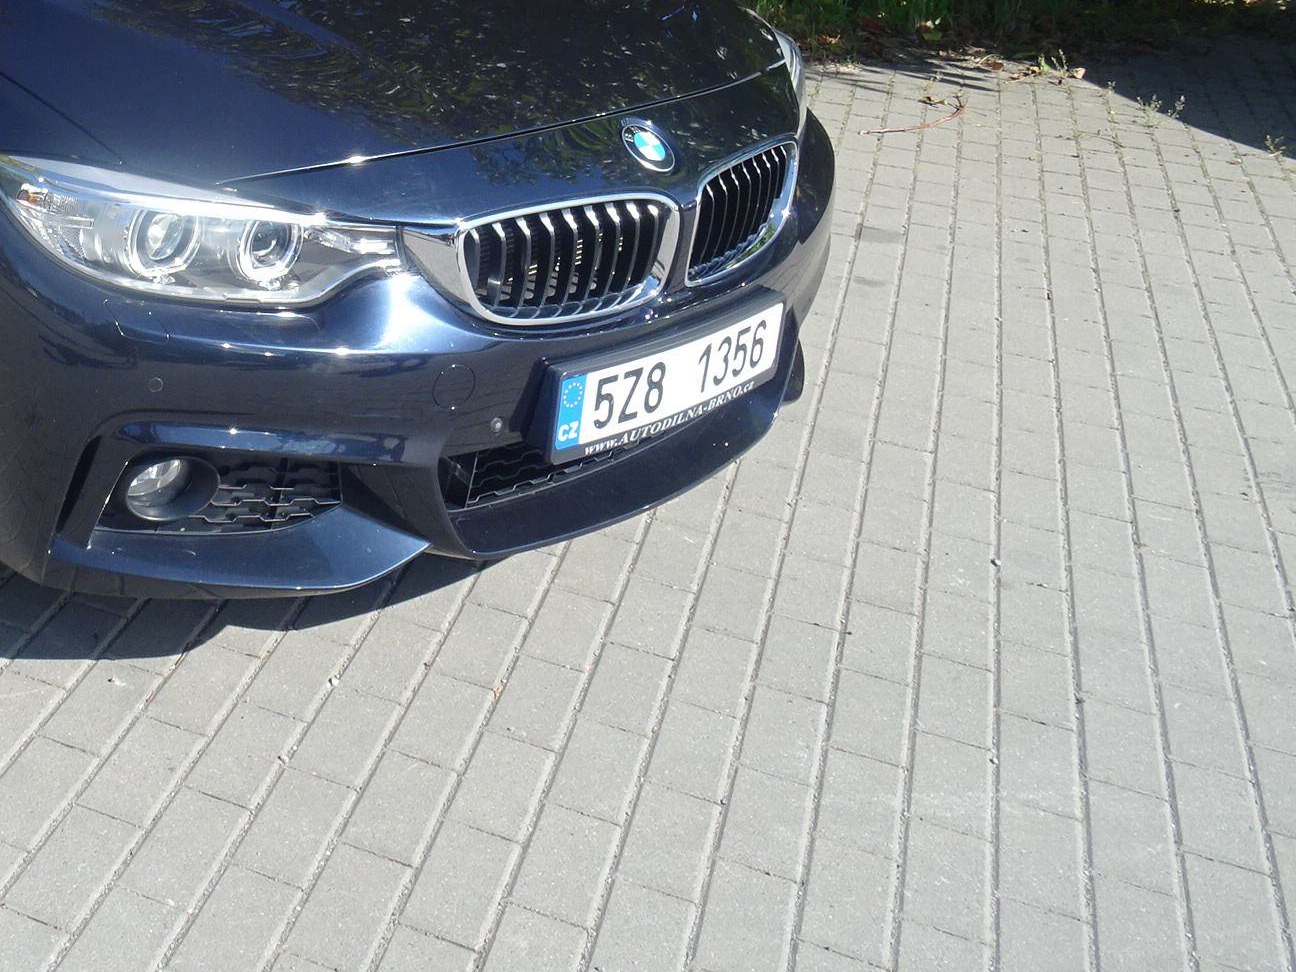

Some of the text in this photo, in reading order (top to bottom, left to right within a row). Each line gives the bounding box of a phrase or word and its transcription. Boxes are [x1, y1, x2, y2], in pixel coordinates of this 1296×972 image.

[593, 320, 767, 429] 5Z8 1356
[557, 420, 580, 442] CZ
